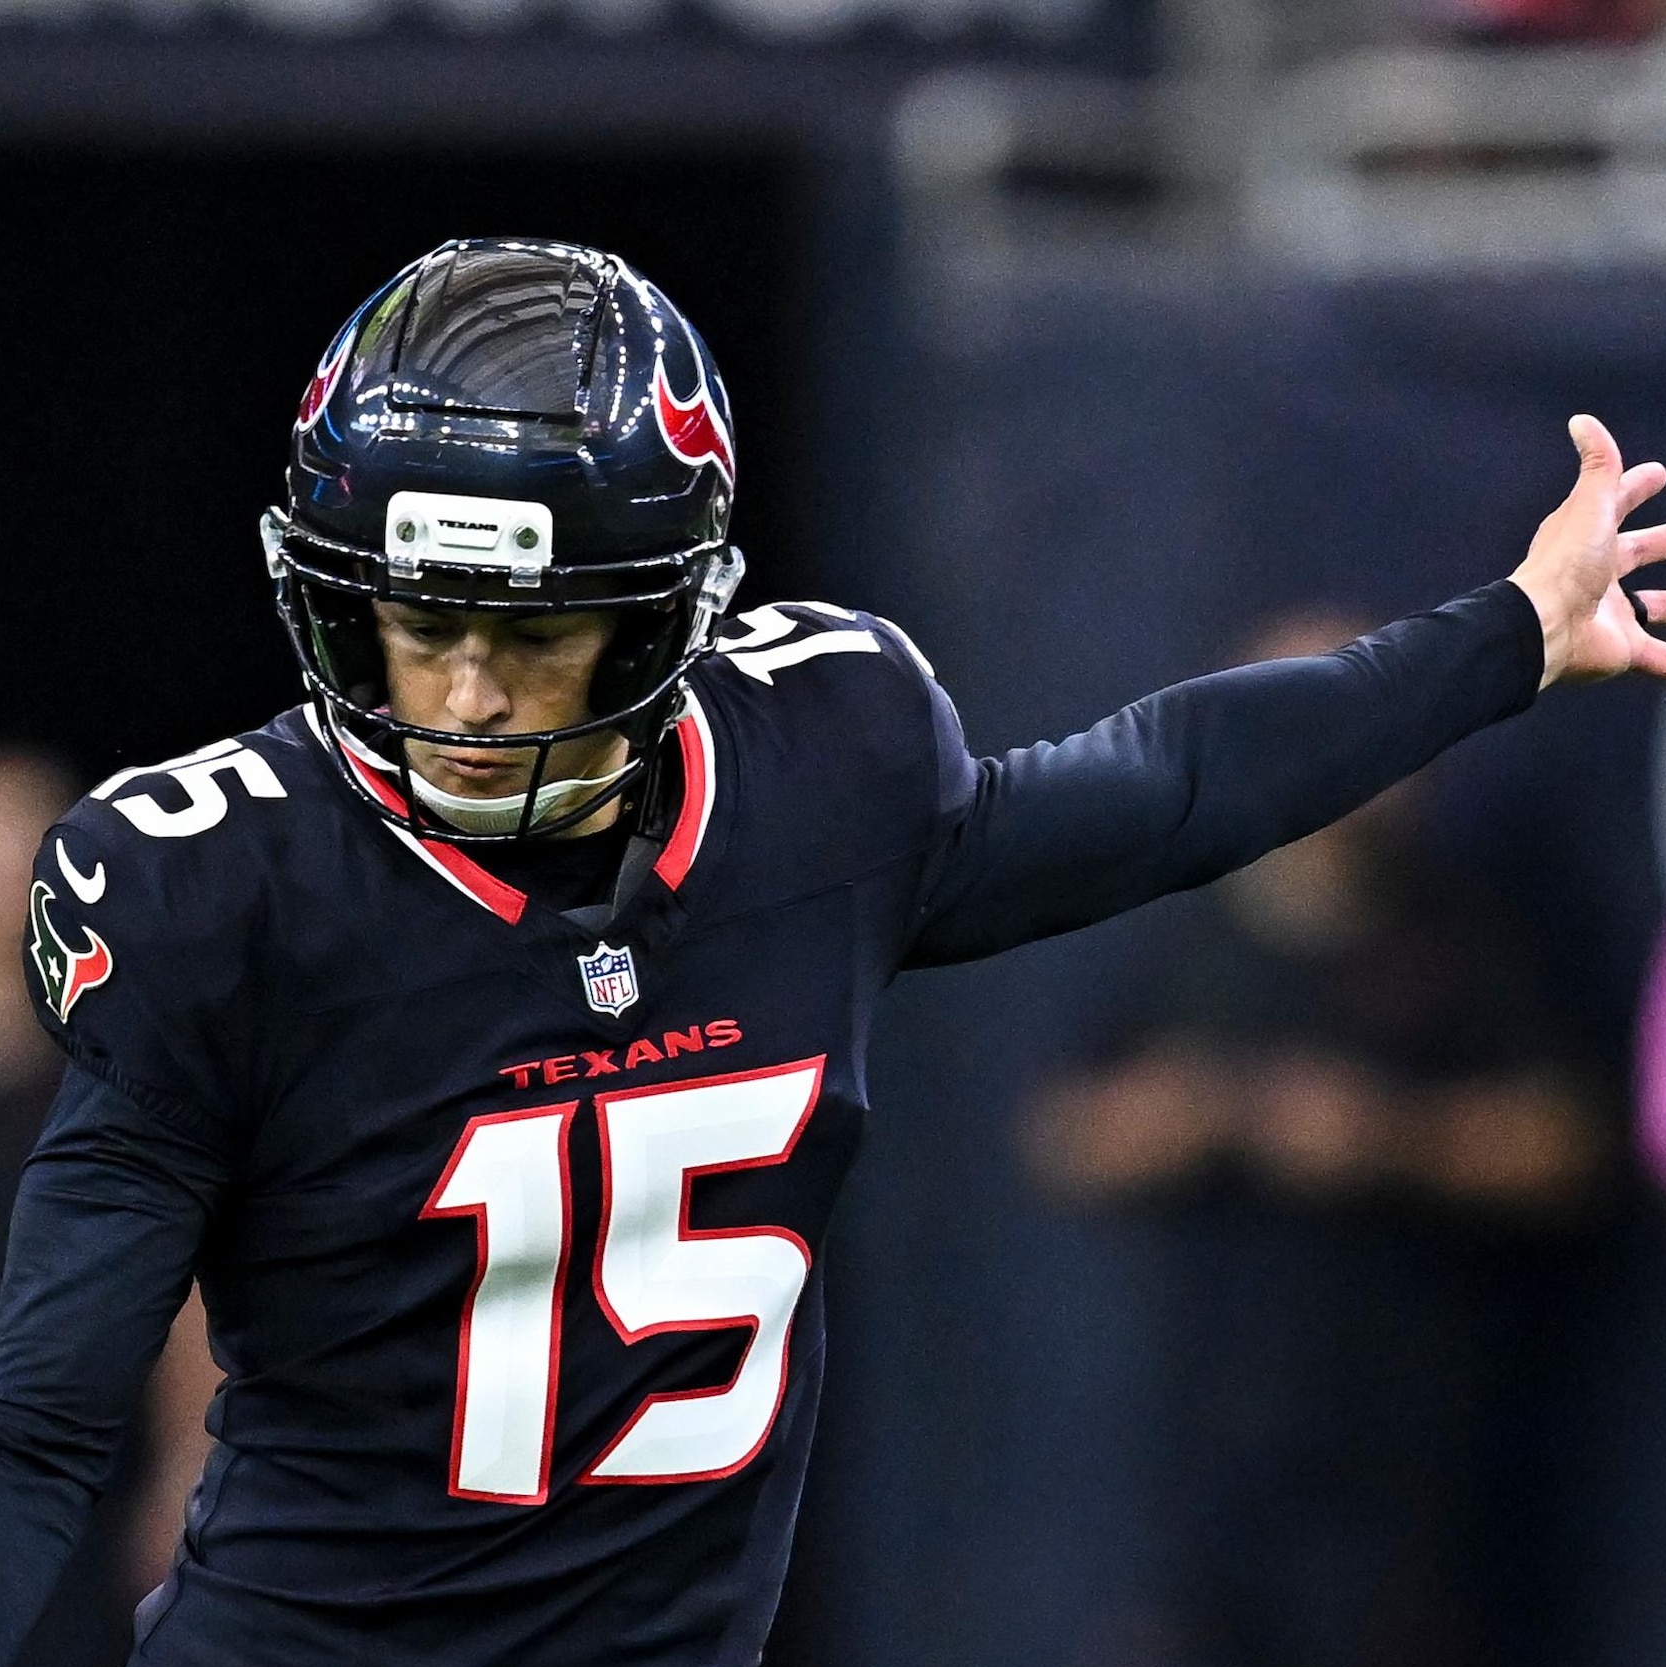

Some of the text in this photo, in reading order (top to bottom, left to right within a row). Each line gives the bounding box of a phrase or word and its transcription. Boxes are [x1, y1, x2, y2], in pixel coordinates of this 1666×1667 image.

[437, 519, 498, 532] TEXANS
[593, 975, 630, 1004] NFL
[498, 1019, 743, 1089] TEXANS
[418, 1054, 827, 1505] 15
